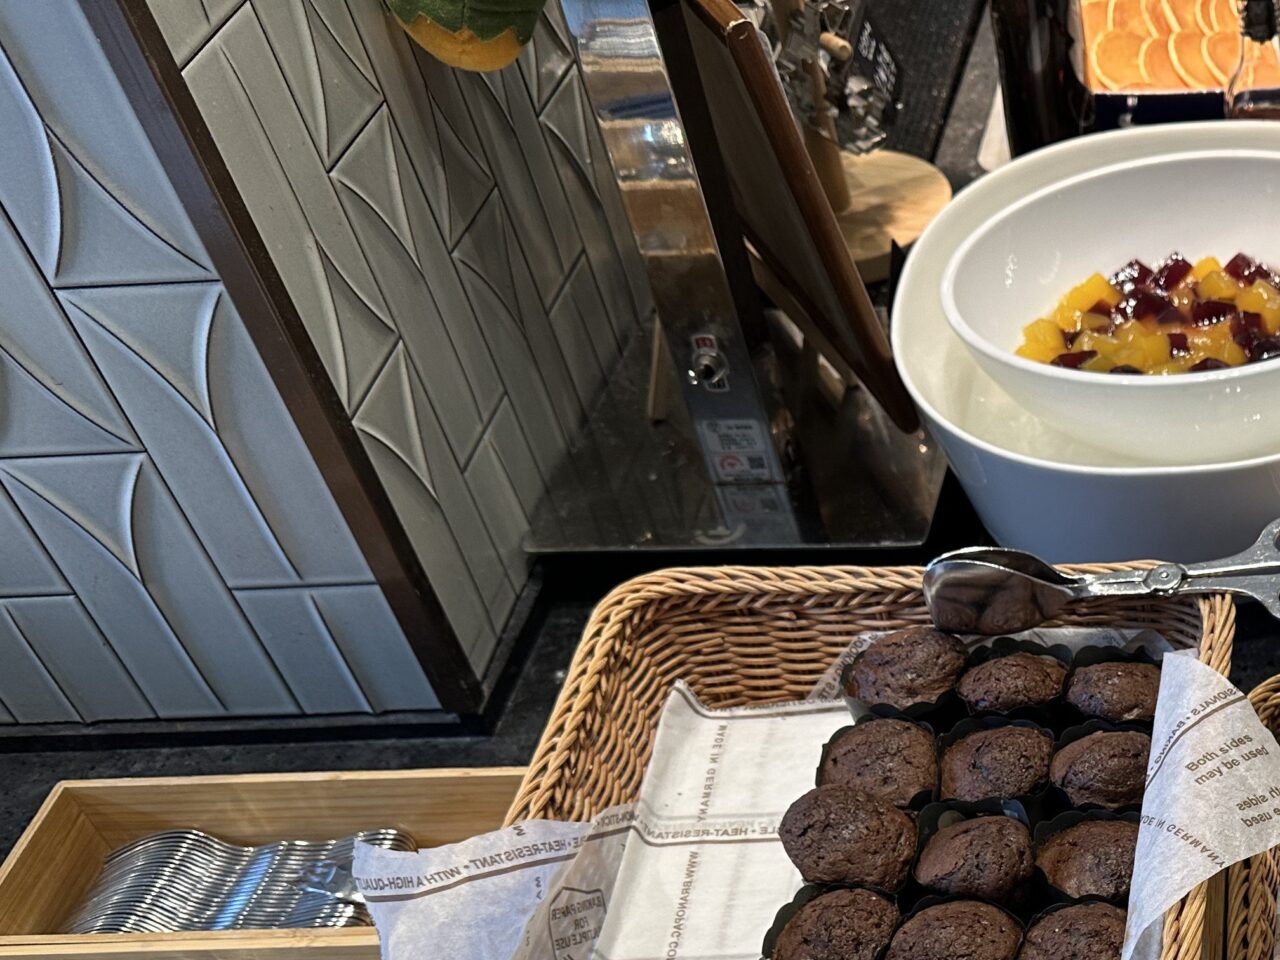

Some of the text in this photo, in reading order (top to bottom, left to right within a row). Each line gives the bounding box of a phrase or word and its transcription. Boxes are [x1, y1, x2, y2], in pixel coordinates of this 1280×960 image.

[1185, 734, 1254, 772] Both sides
[1194, 744, 1270, 786] may be used
